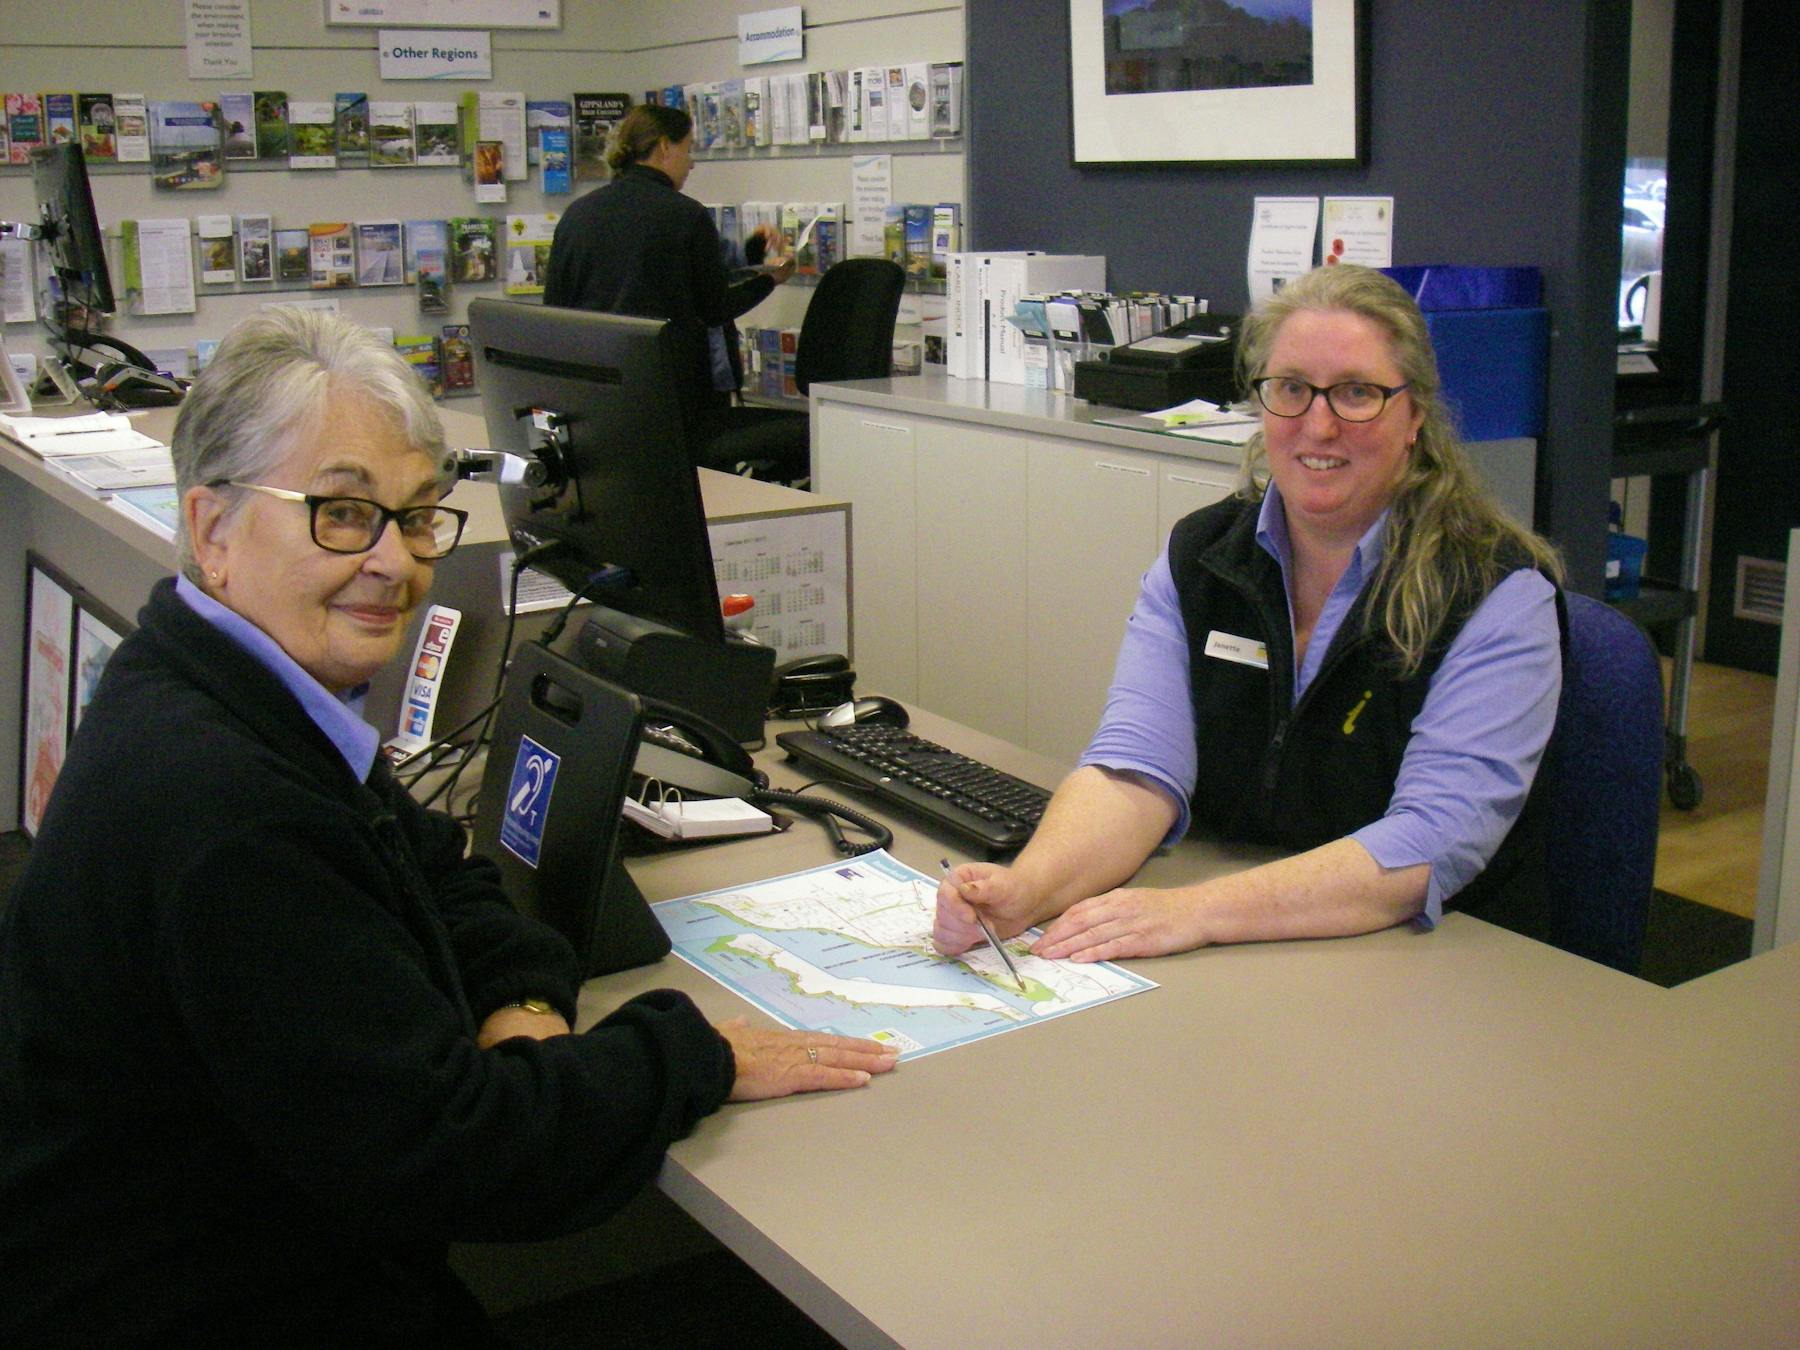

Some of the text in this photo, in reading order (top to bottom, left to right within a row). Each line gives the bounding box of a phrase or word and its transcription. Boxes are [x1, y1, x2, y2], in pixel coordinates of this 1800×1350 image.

[392, 47, 478, 62] Other Regions
[413, 685, 432, 698] VISA
